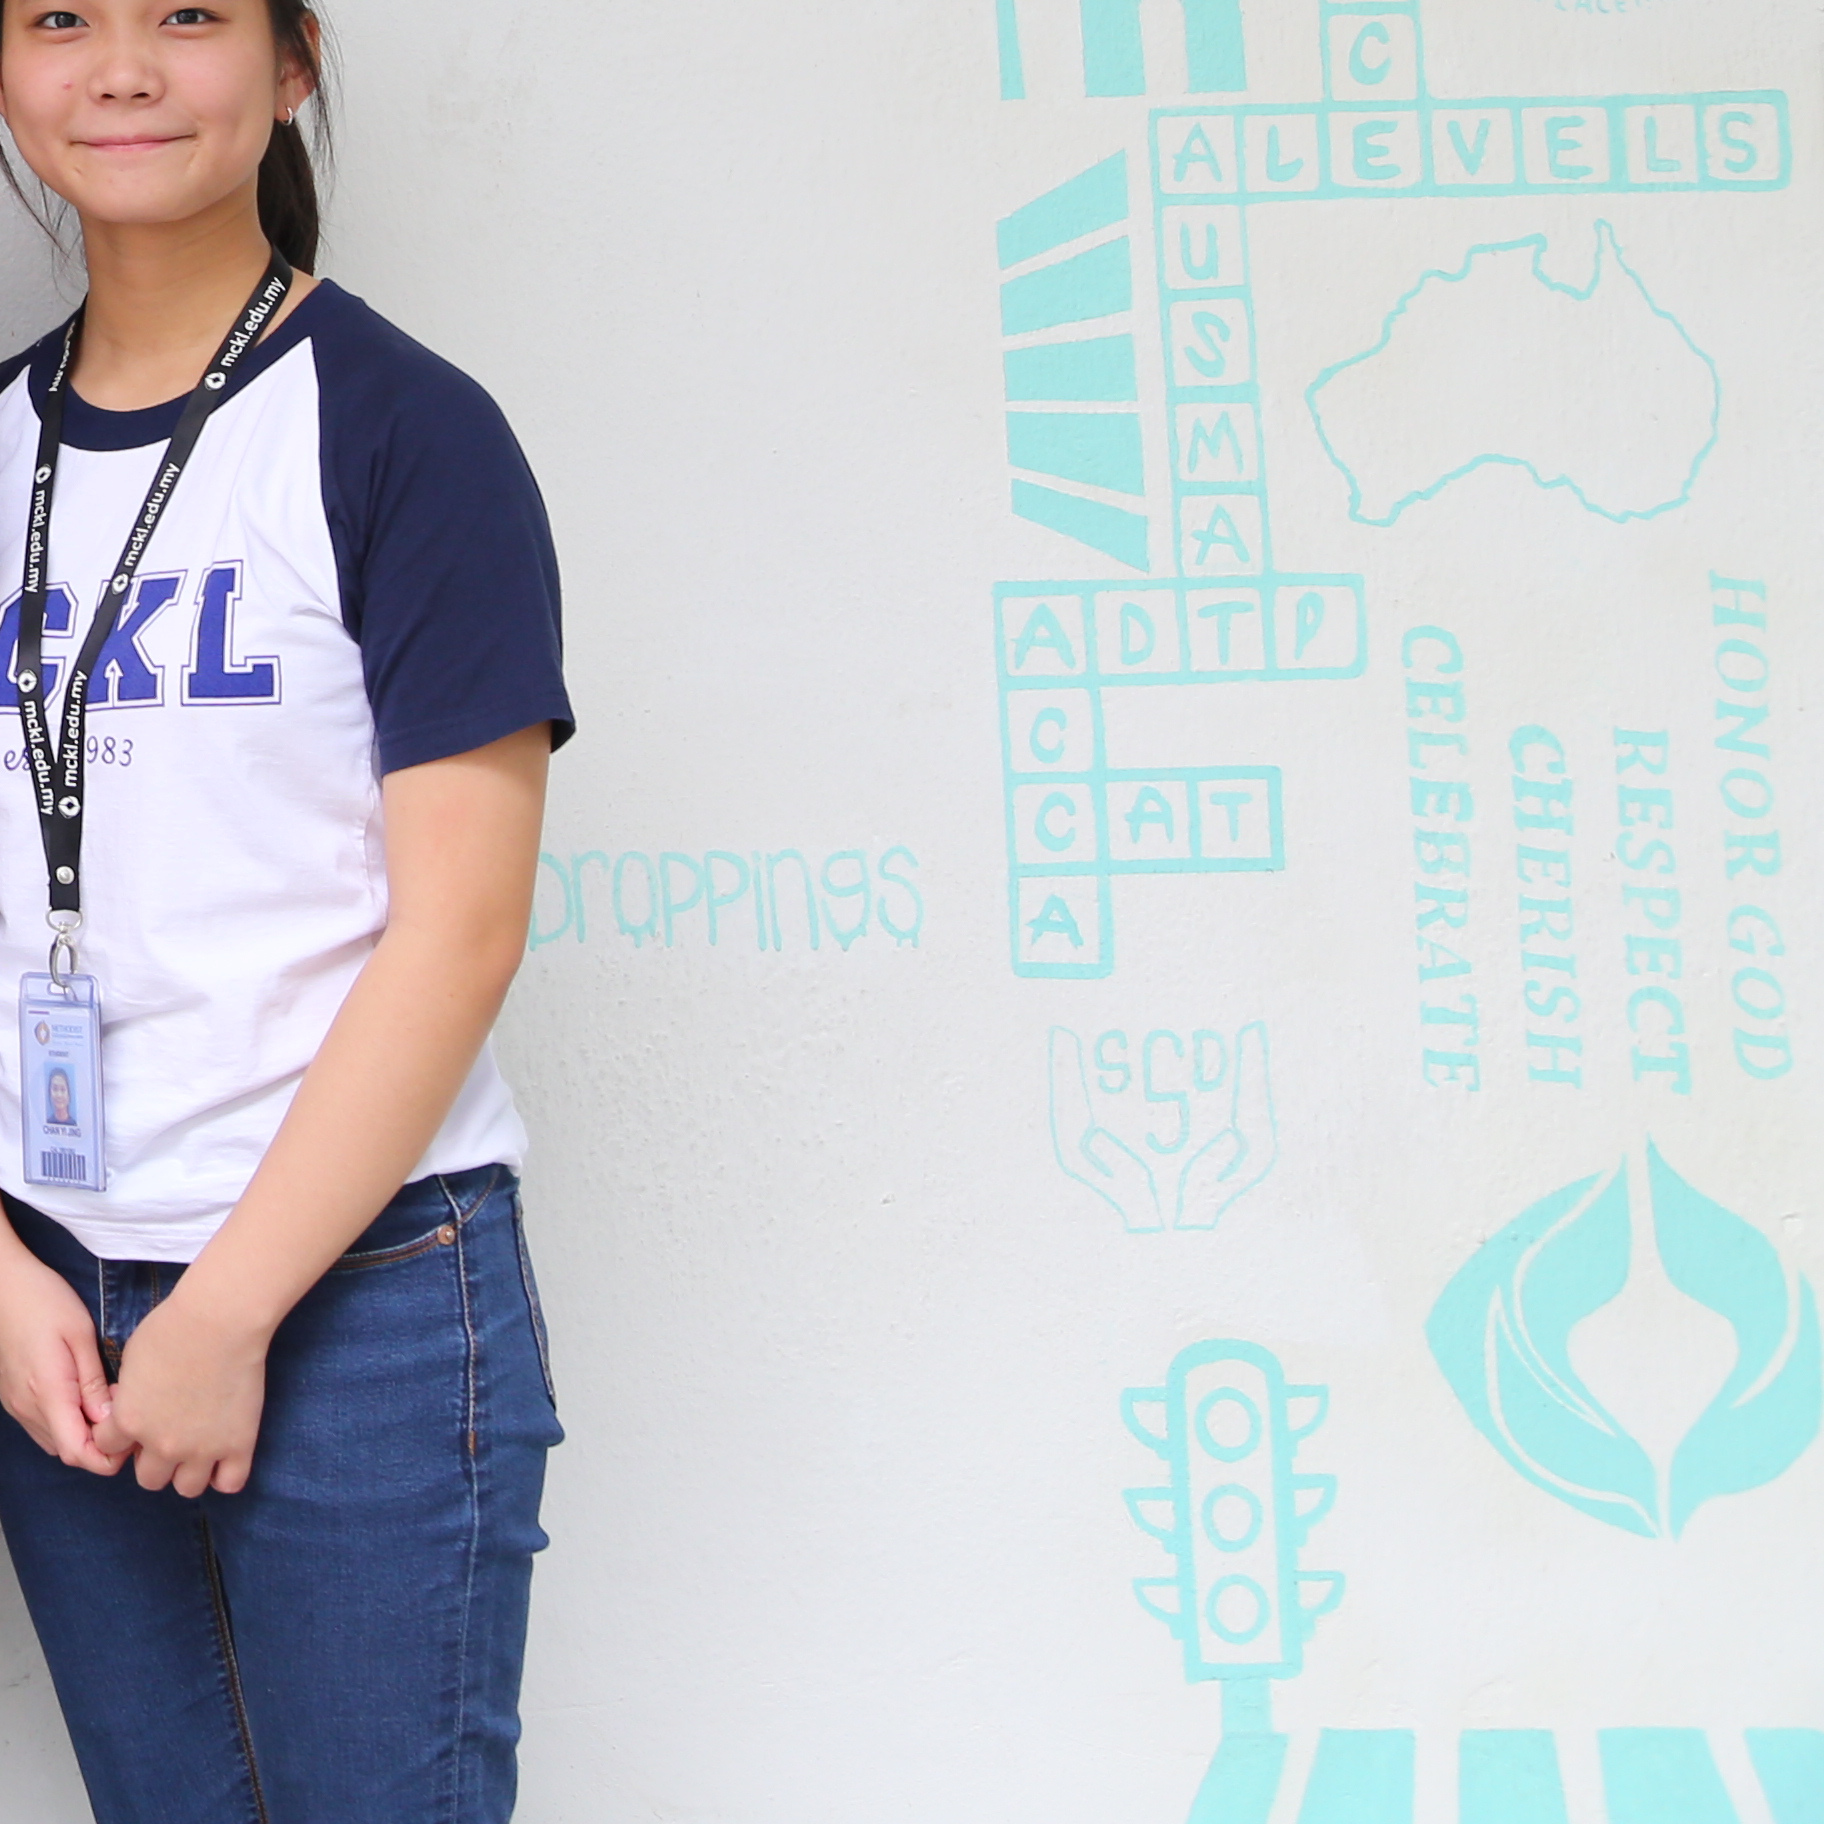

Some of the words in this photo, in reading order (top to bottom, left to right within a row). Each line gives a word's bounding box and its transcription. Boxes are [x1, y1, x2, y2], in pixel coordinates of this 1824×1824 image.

[220, 276, 286, 368] mckl.edu.my
[25, 489, 45, 593] mckl.edu.my
[123, 462, 180, 568] mckl.edu.my
[24, 700, 53, 816] mckl.edu.my
[64, 670, 87, 787] mckl.edu.my
[86, 736, 134, 767] 983
[1708, 569, 1784, 880] HONOR
[1400, 624, 1483, 1092] CELEBRATE
[1507, 723, 1585, 1090] CHERISH
[1612, 726, 1694, 1096] RESPECT
[1725, 903, 1796, 1080] GOD
